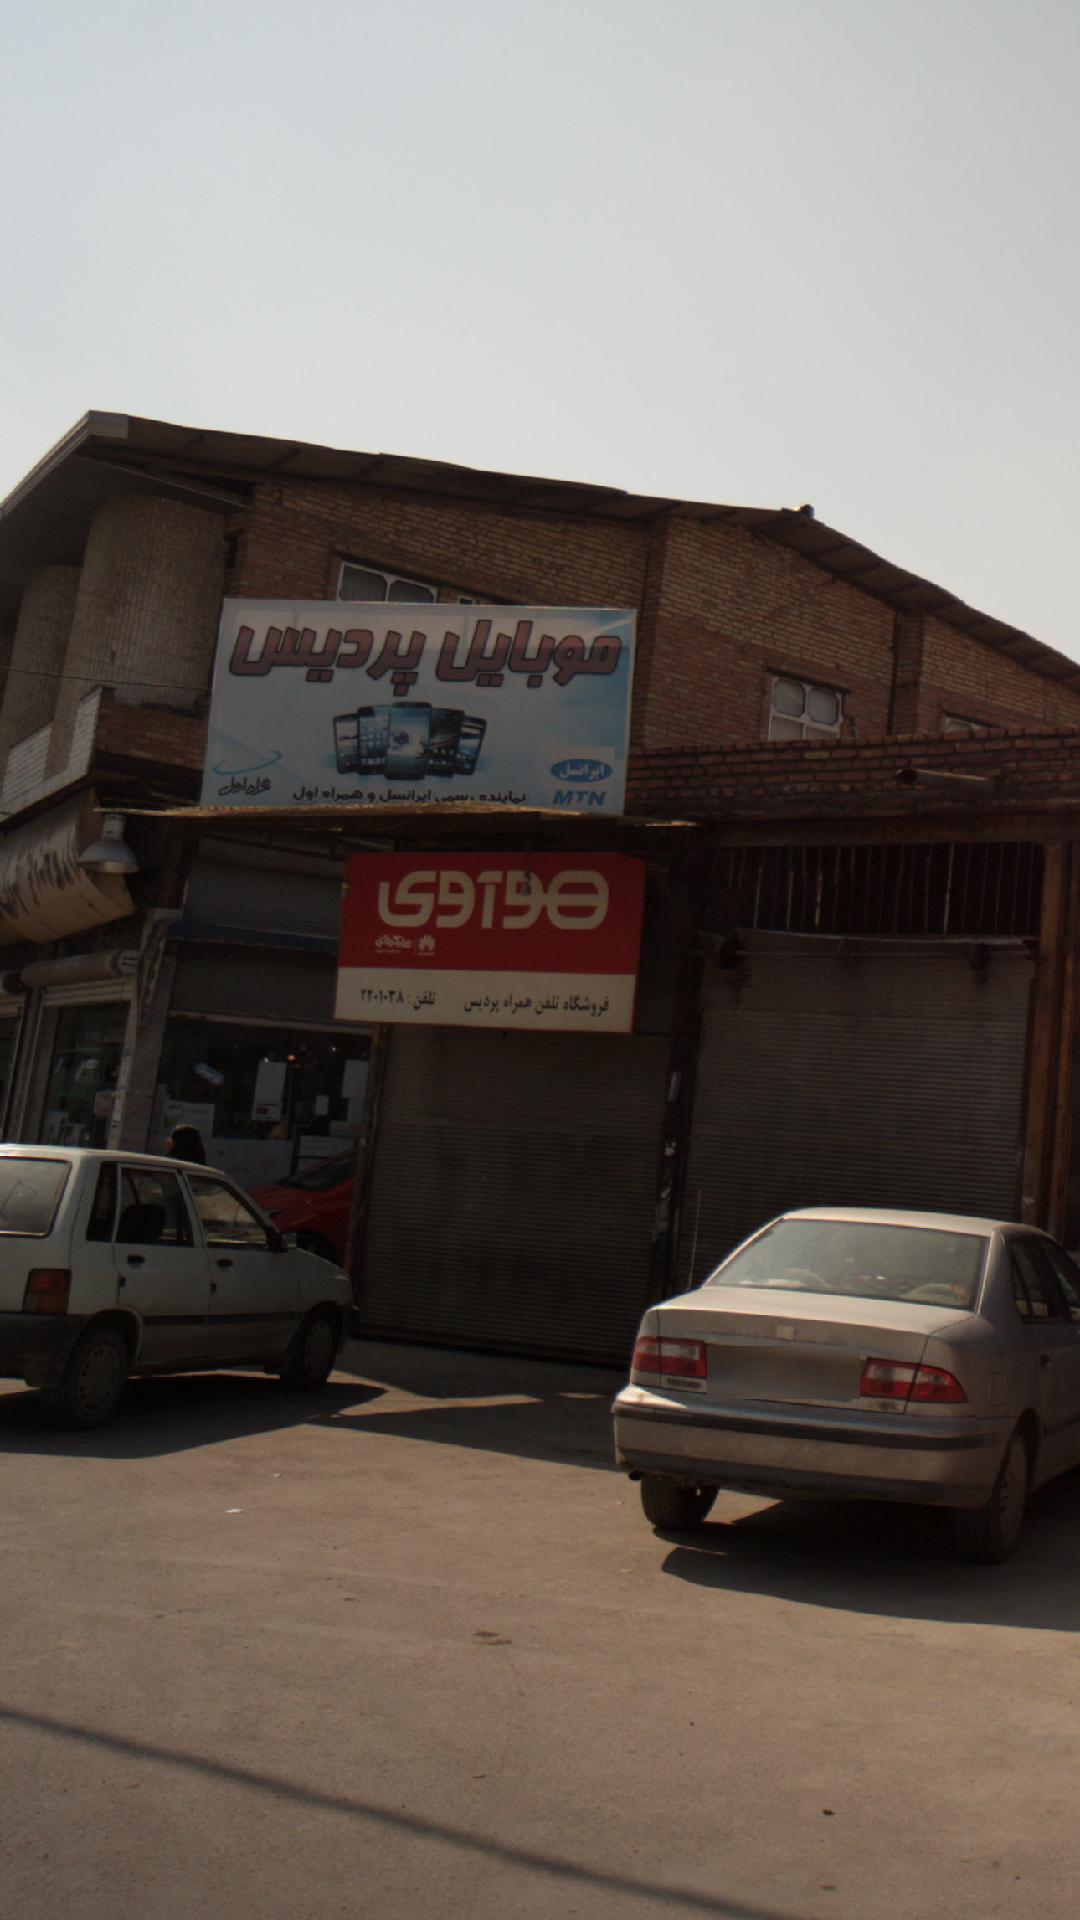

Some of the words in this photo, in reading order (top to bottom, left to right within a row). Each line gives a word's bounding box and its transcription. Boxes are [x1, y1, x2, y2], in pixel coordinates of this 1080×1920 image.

[228, 623, 427, 698] پردیس
[434, 619, 623, 688] موبایل
[559, 763, 606, 781] ایرانسل
[292, 786, 319, 802] اول
[322, 787, 363, 802] همراه
[367, 792, 376, 803] و
[379, 788, 432, 803] ایرانسل
[479, 790, 526, 804] نماینده
[552, 790, 606, 806] MTN
[503, 992, 533, 1014] همراه
[534, 994, 560, 1015] تلفن
[562, 994, 609, 1017] فروشگاه
